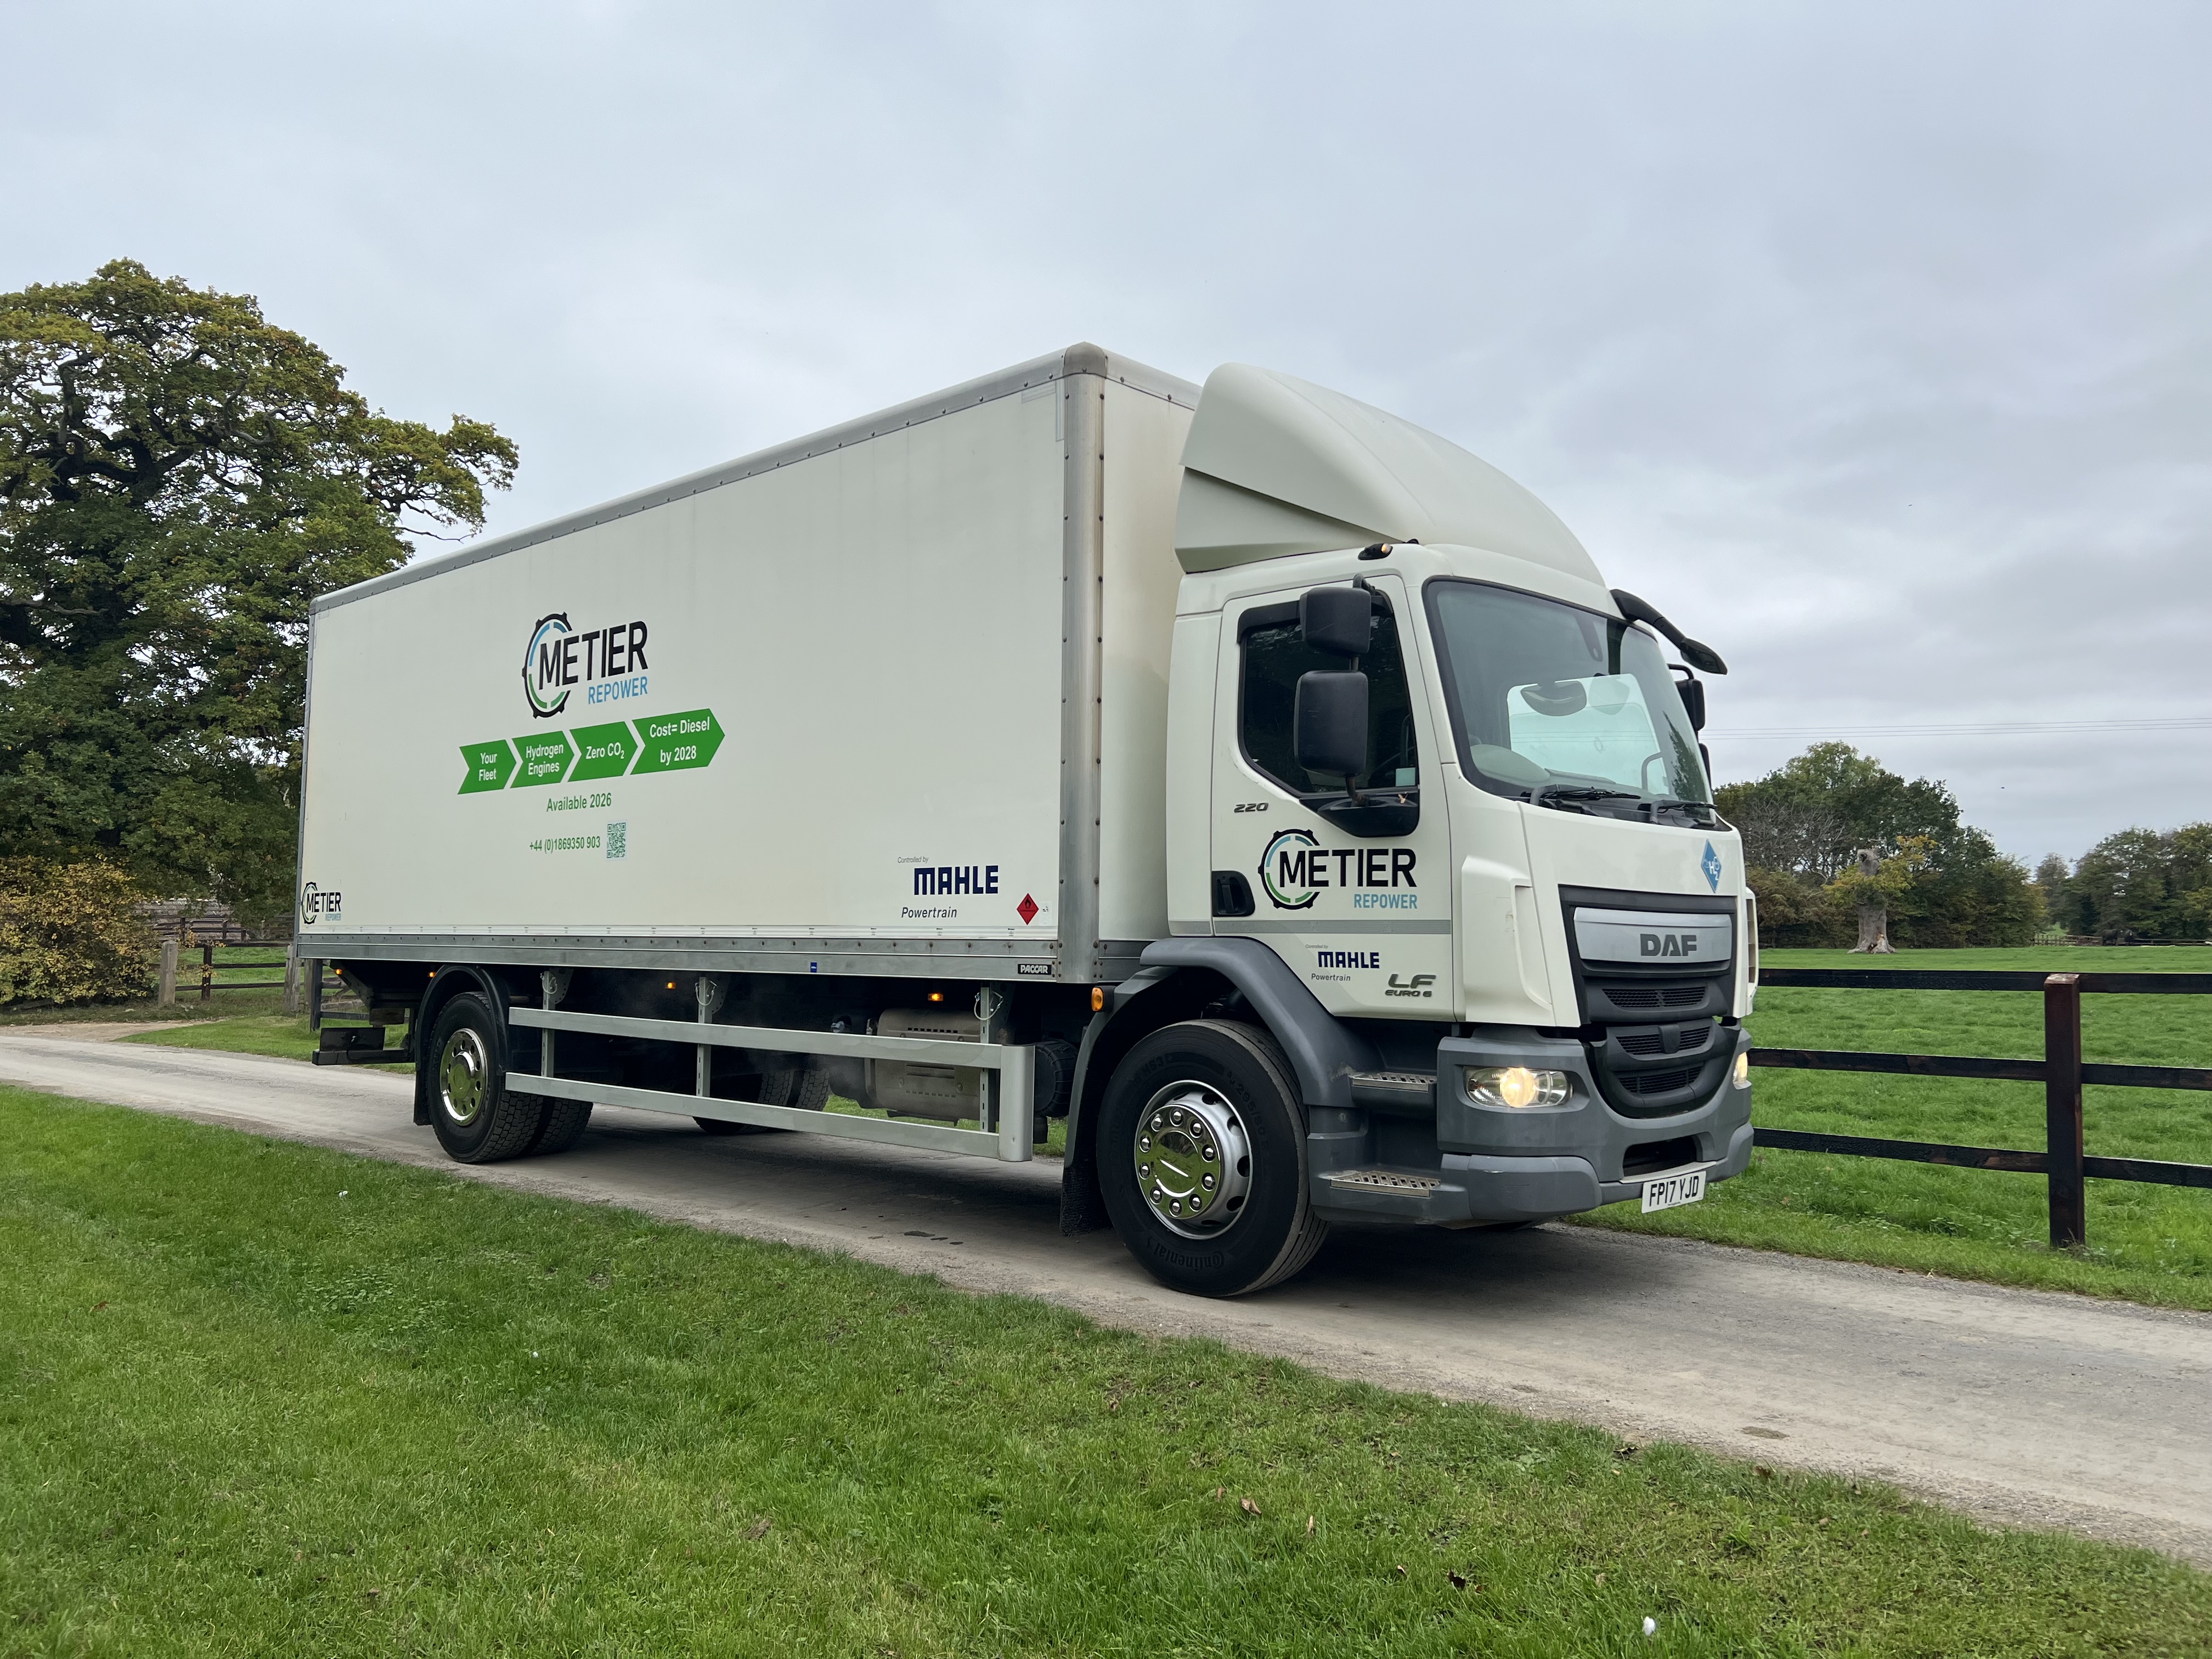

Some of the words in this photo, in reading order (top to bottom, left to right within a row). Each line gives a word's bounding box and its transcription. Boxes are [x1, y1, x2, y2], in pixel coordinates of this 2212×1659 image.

[539, 620, 648, 690] METIER
[588, 676, 648, 704] REPOWER
[680, 716, 710, 734] Diesel
[480, 752, 498, 764] Your
[526, 744, 564, 760] Hydrogen
[585, 746, 605, 759] Zero
[660, 749, 672, 766] by
[674, 745, 697, 761] 2028
[478, 769, 496, 781] Fleet
[528, 761, 560, 777] Engines
[546, 795, 587, 812] Available
[590, 792, 612, 808] 2026
[1234, 802, 1268, 812] 220
[529, 839, 542, 851] +44
[544, 837, 585, 854] (0)1869350
[586, 836, 601, 849] 903
[1280, 848, 1417, 888] METIER
[914, 865, 998, 895] MAHLE
[306, 892, 341, 913] METIER
[1354, 894, 1418, 909] REPOWER
[901, 906, 957, 918] Powertrain
[1640, 933, 1697, 957] DAF
[1020, 964, 1048, 974] PACCAR
[1318, 951, 1380, 969] MAHLE
[1311, 973, 1351, 981] Powertrain
[1388, 974, 1436, 988] LF
[1649, 1180, 1677, 1206] FP17
[1680, 1176, 1699, 1200] YJD
